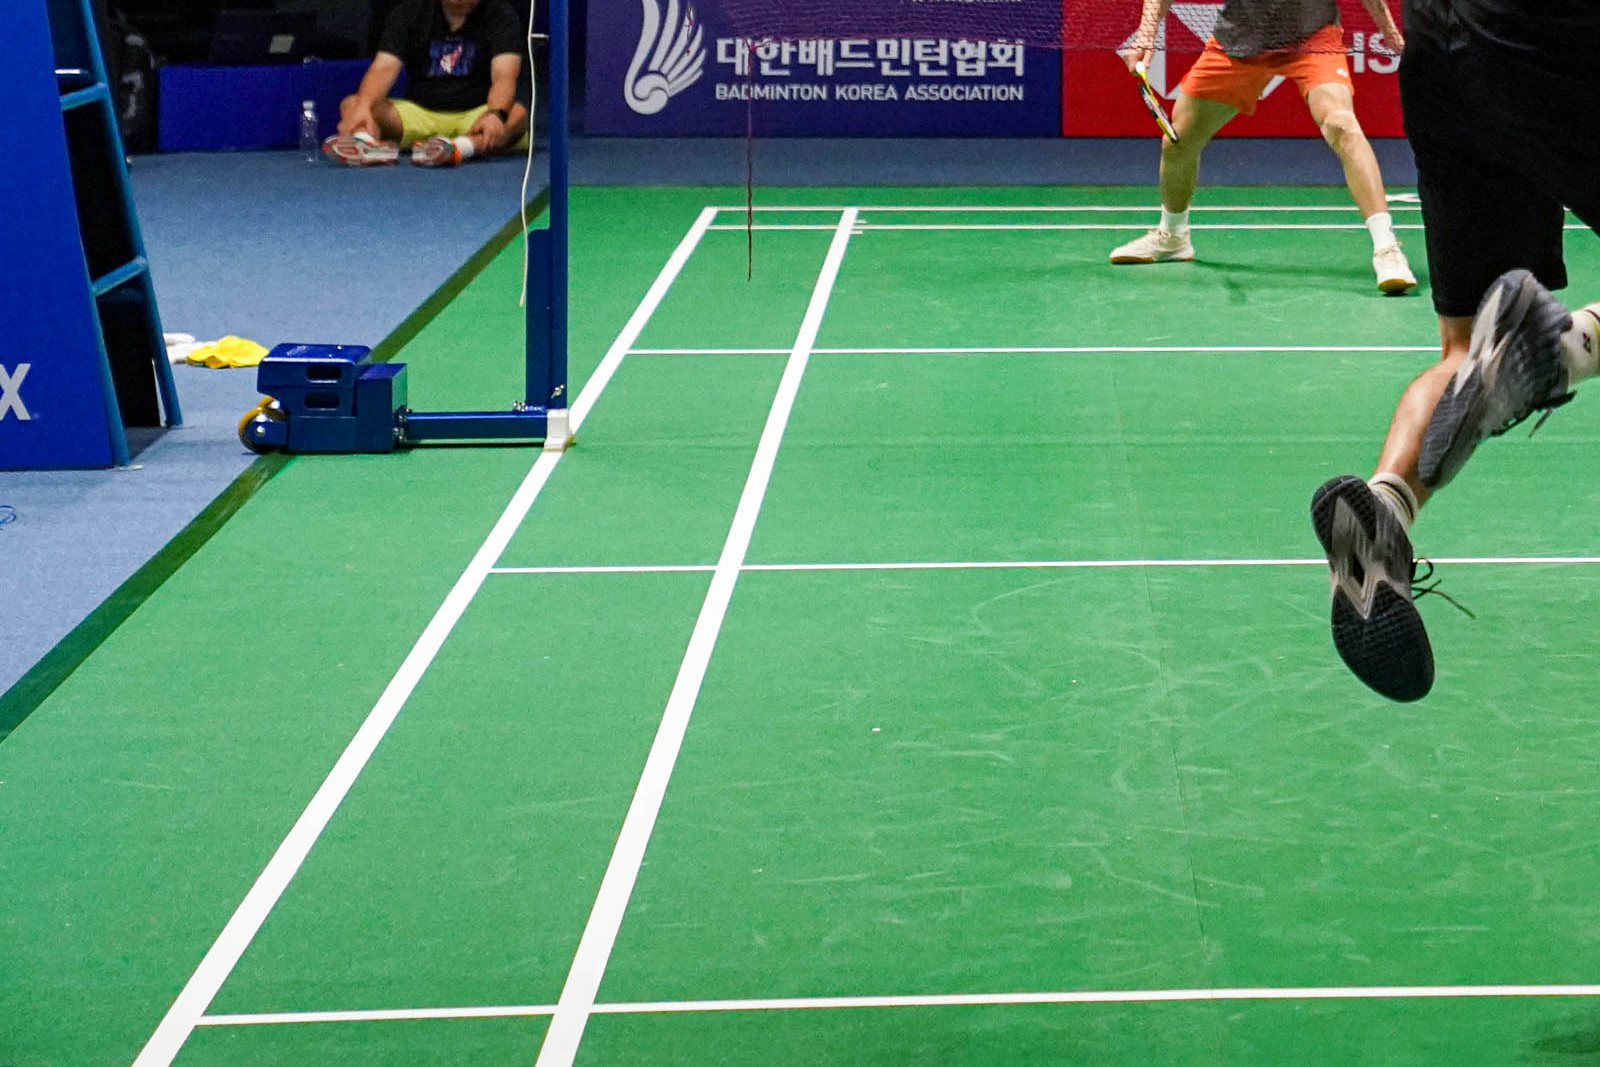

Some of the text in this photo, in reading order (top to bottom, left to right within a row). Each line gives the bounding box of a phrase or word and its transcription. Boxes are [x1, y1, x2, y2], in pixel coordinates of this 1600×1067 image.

[716, 37, 1024, 76] 대한배드민턴협회
[716, 84, 1024, 101] BADMINTON KOREA ASSOCIATION
